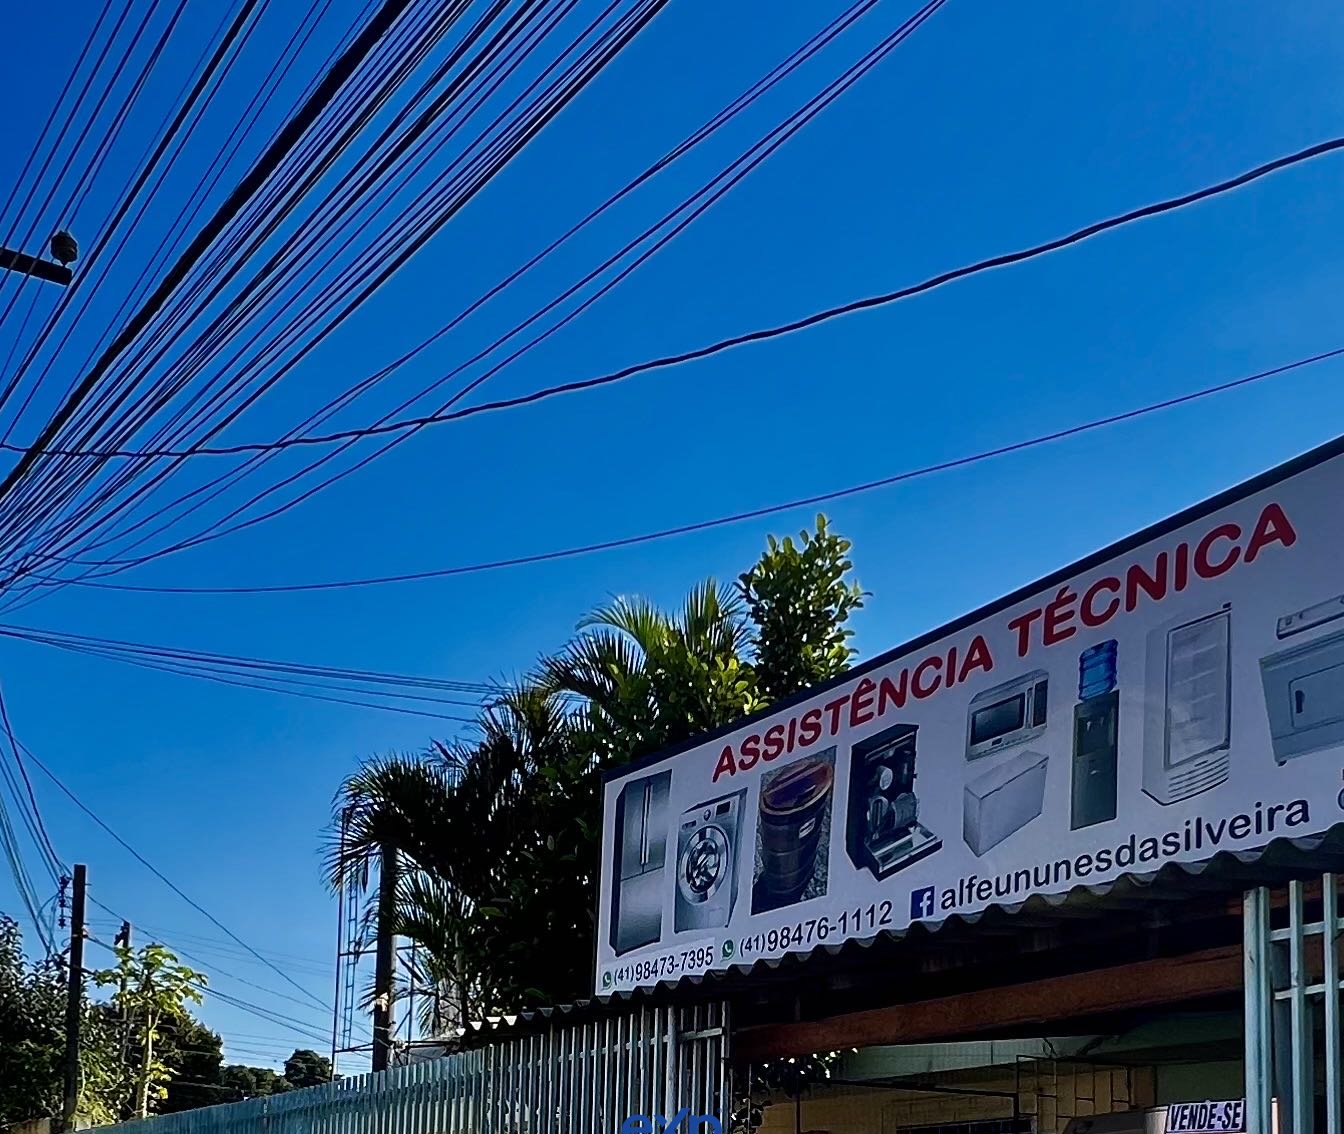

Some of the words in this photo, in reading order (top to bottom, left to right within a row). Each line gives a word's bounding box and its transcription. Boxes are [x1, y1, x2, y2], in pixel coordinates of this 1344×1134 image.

[711, 635, 994, 784] ASSISTÊNCIA
[1007, 502, 1297, 658] TÉCNICA
[614, 945, 714, 985] (41)98473-7395
[739, 900, 893, 958] (41)98476-1112
[940, 799, 1310, 910] alfeununesdasilveira
[1171, 1102, 1242, 1130] VENDE-SE
